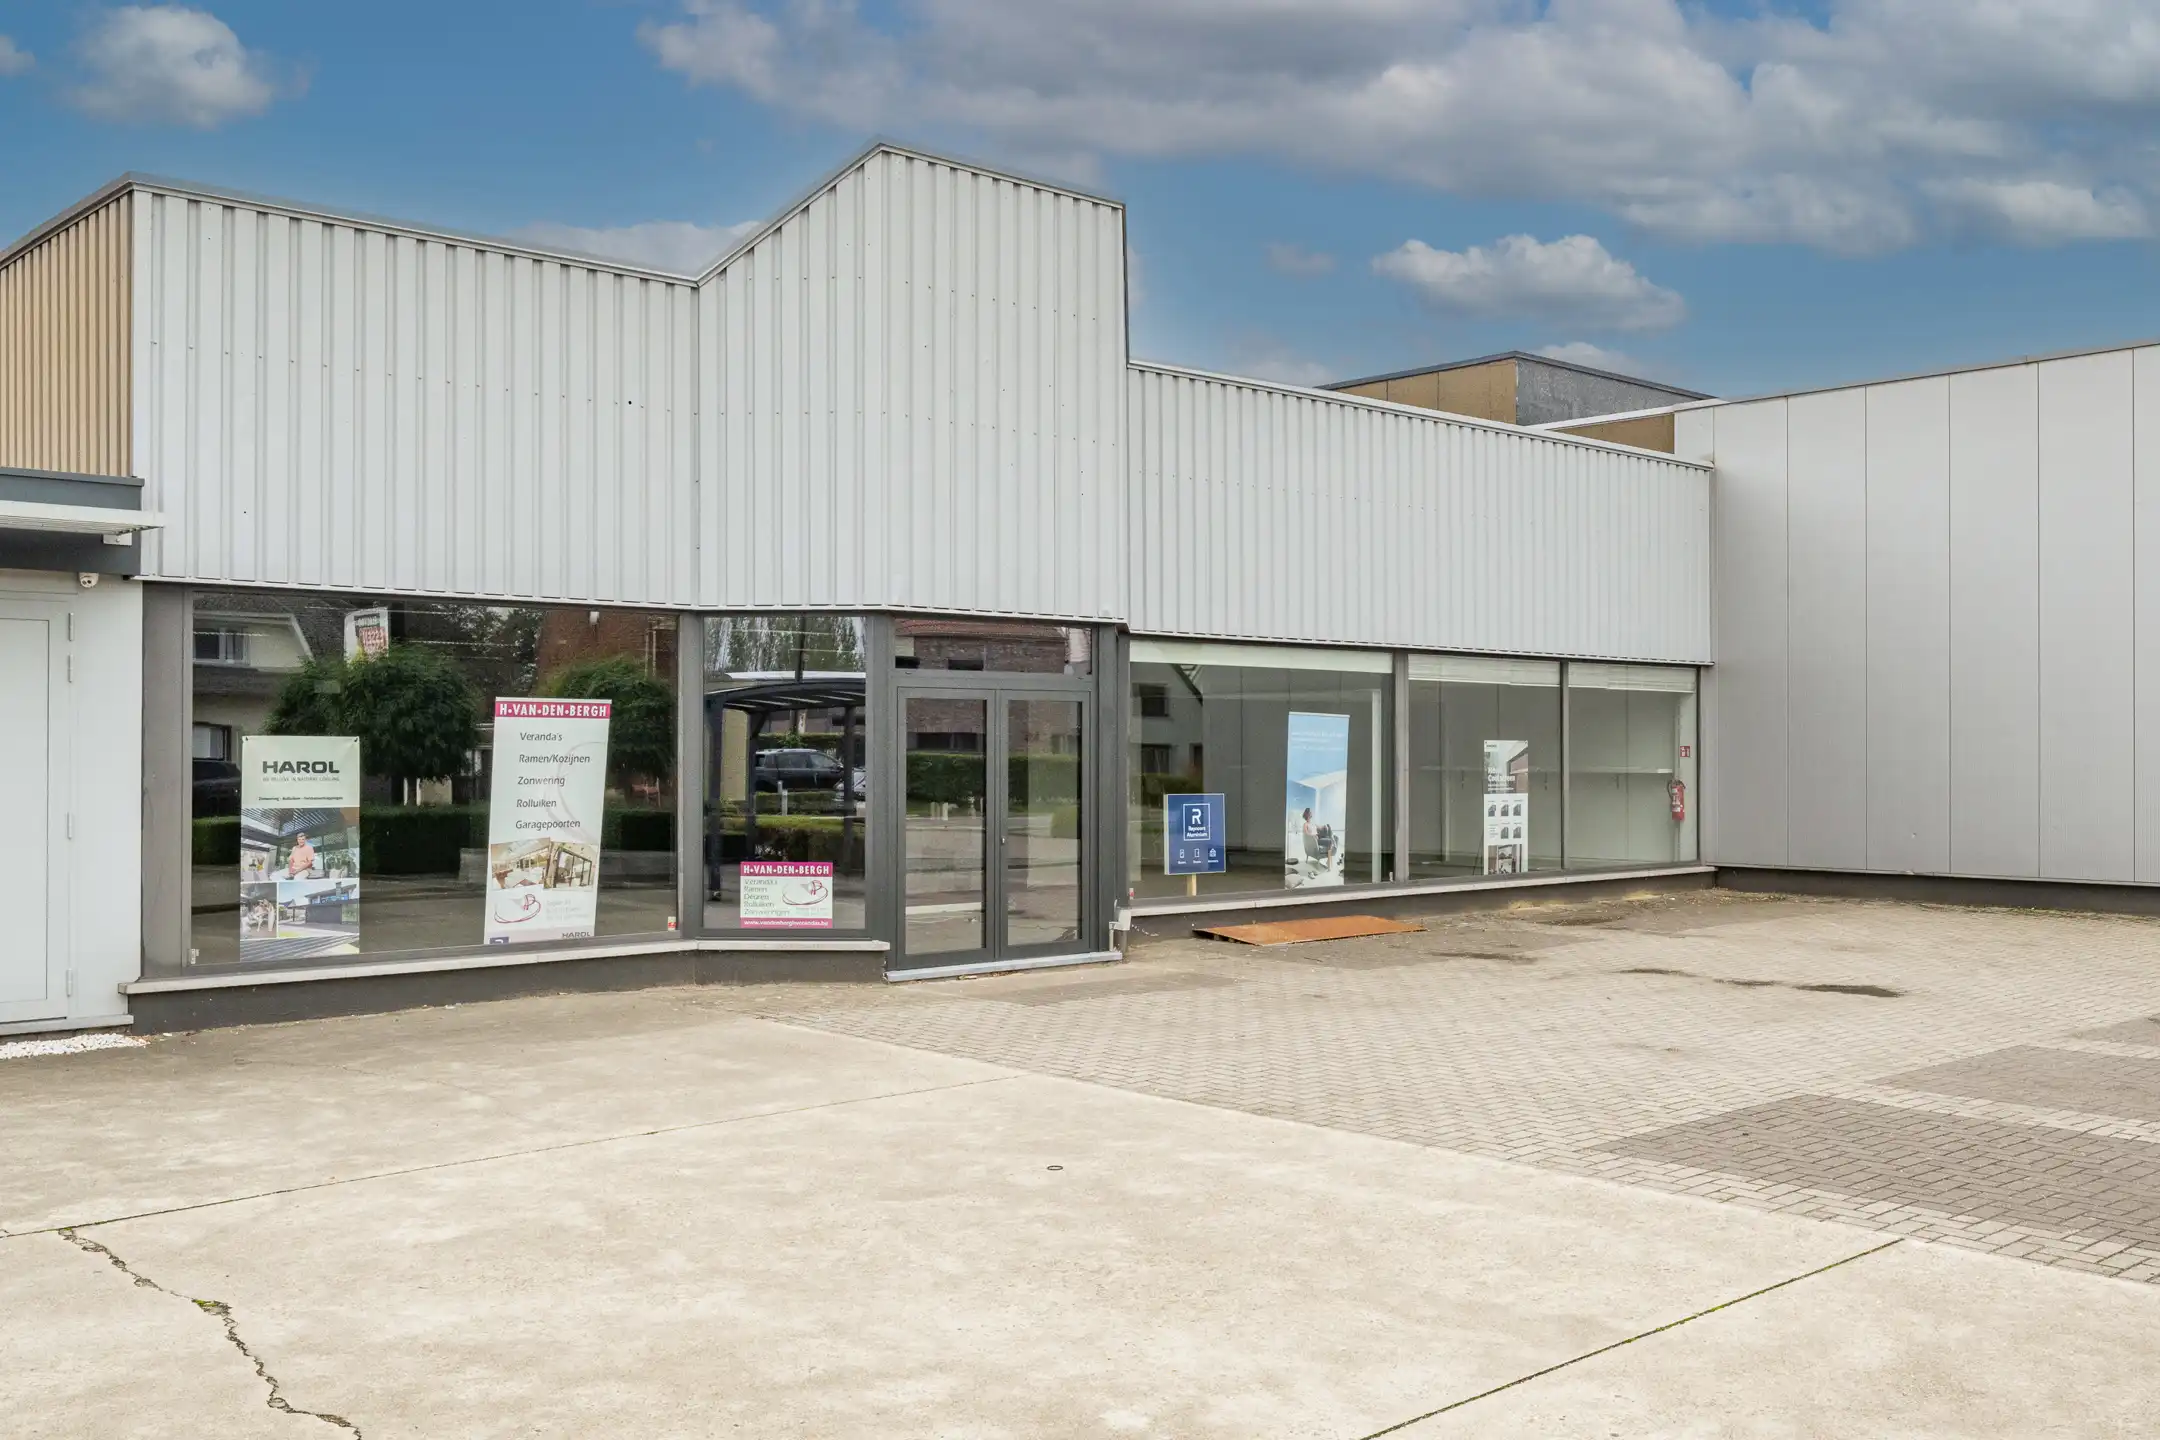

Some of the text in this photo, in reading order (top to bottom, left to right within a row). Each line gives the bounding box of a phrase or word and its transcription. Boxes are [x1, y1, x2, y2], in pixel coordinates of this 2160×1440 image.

[519, 732, 563, 741] Veranda's
[518, 754, 591, 766] Ramen/Kozijnen
[262, 761, 340, 774] HAROL
[517, 776, 566, 787] Zonwering
[516, 799, 557, 808] Rolluiken
[515, 820, 581, 831] Garagepoorten
[561, 931, 591, 939] HAROL
